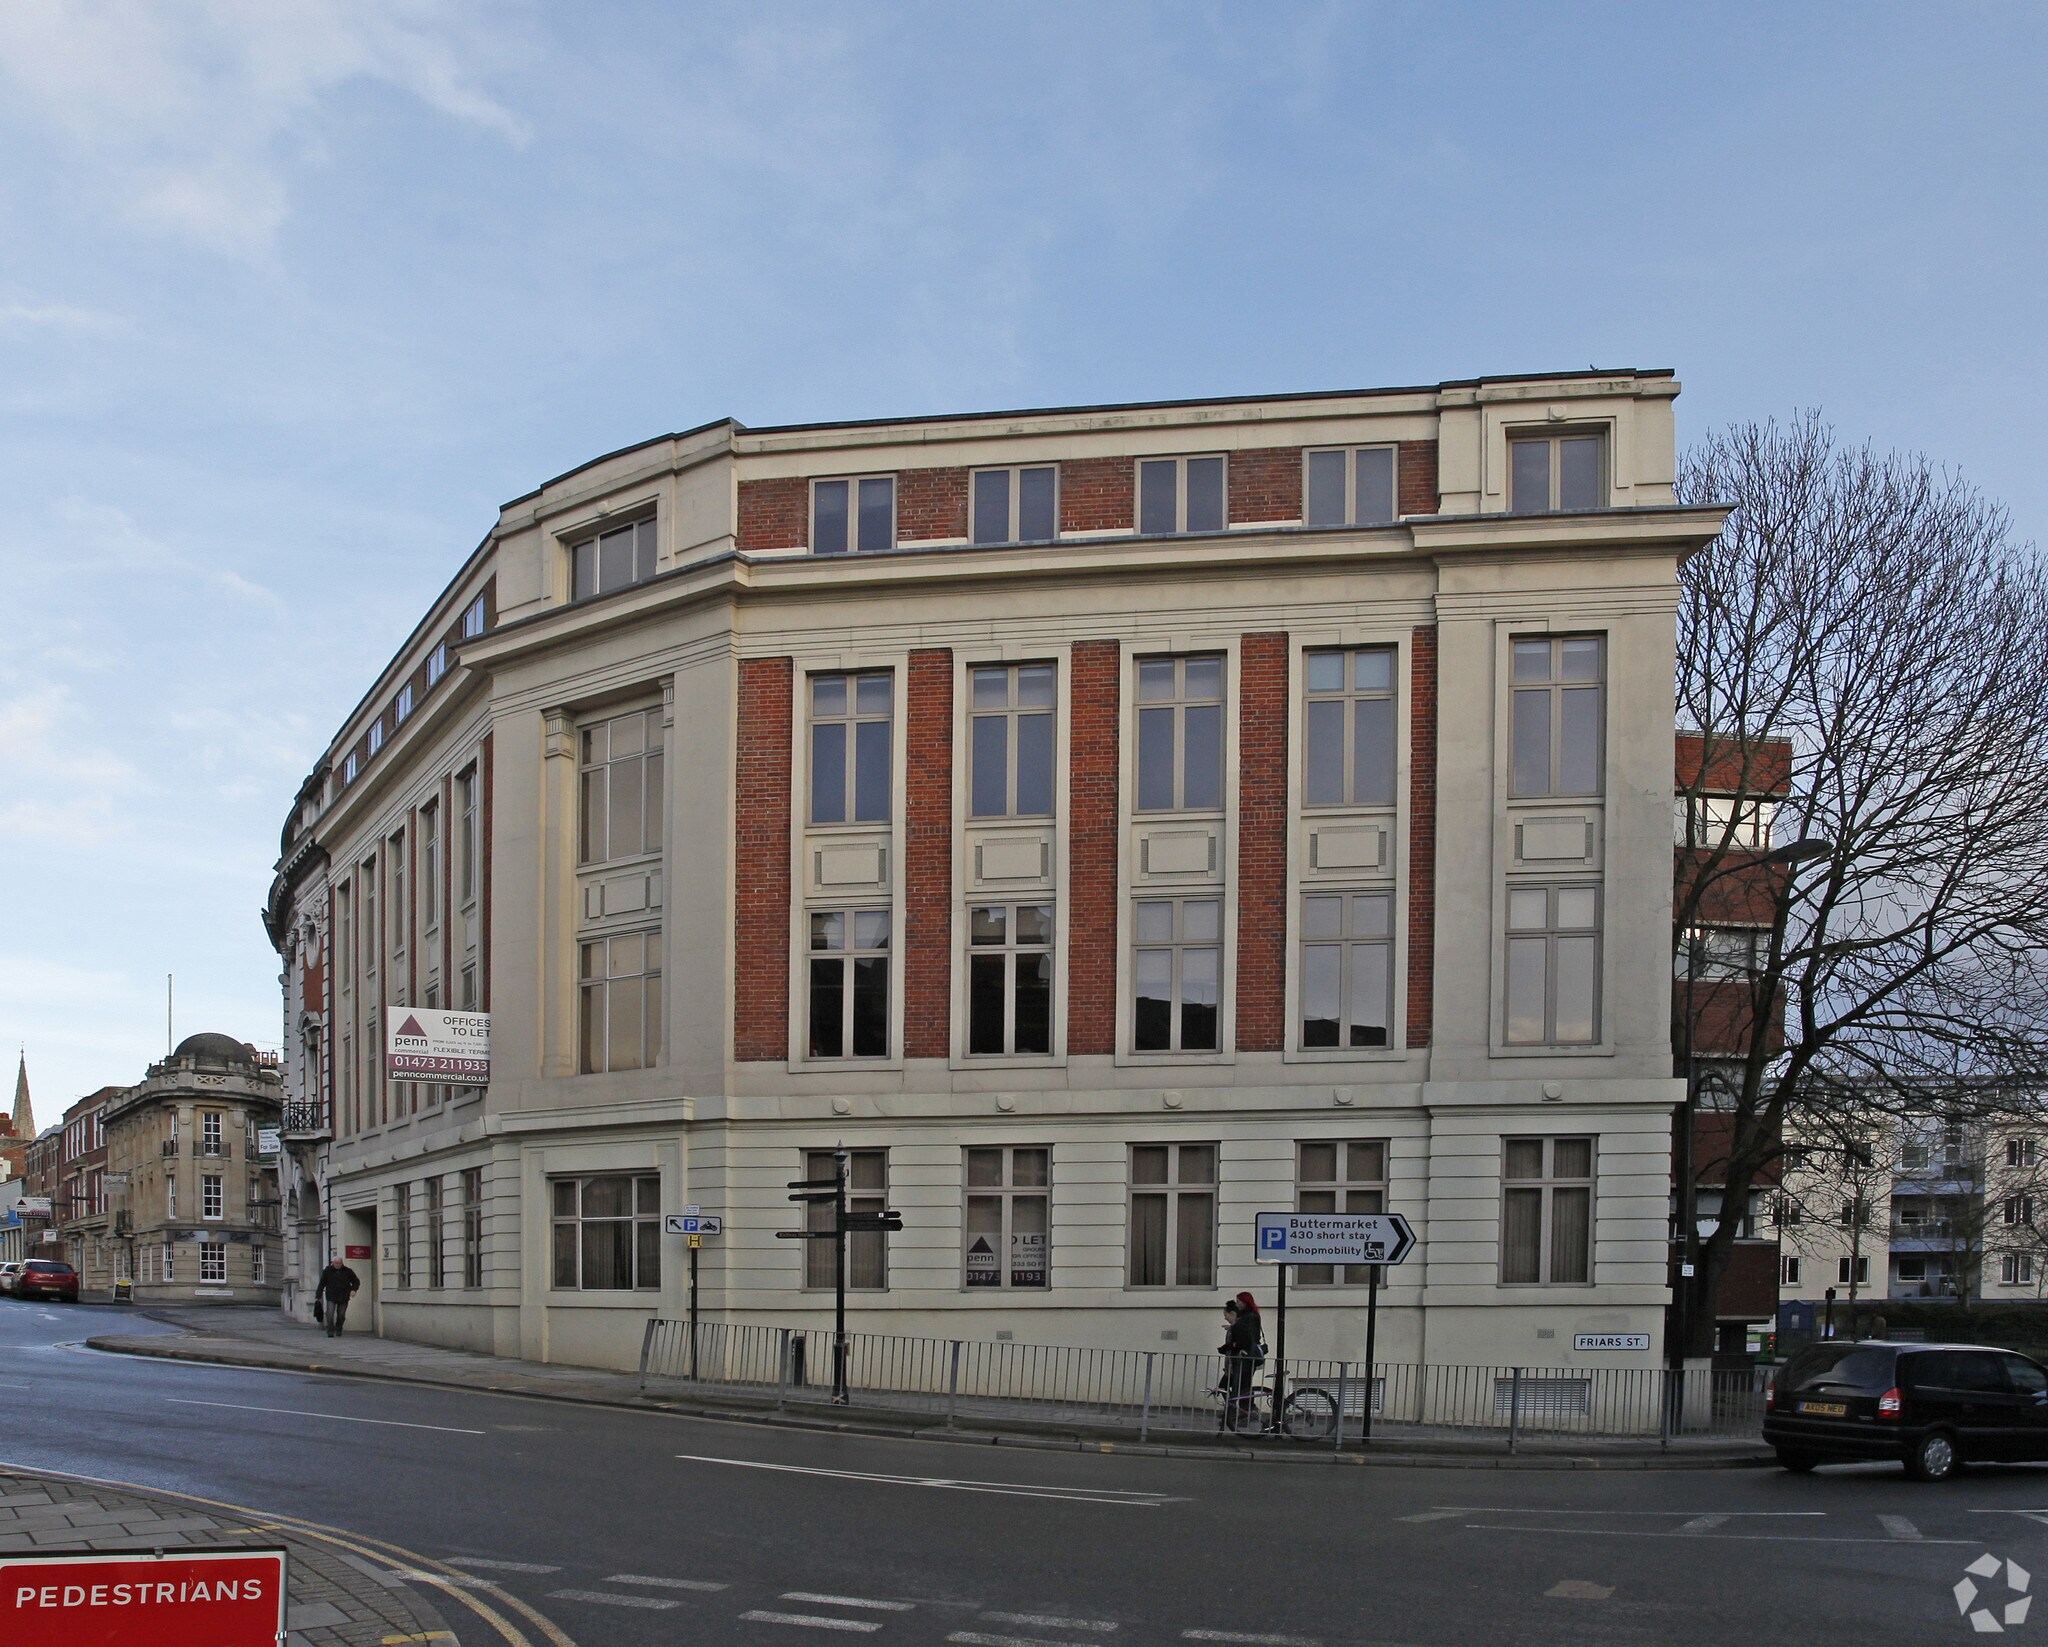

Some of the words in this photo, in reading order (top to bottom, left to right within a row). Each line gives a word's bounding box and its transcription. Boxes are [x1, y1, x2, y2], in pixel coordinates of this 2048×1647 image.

[443, 1016, 491, 1028] OFFICES
[451, 1027, 467, 1036] TO
[470, 1029, 491, 1037] LET
[395, 1037, 428, 1047] penn
[433, 1047, 466, 1055] FLEXIBLE
[395, 1056, 436, 1068] 01473
[440, 1058, 488, 1071] 211933
[393, 1070, 490, 1082] penncommercial.co.uk
[686, 1220, 697, 1231] P
[1290, 1218, 1378, 1229] Buttermarket
[1023, 1235, 1046, 1245] LET
[1266, 1229, 1283, 1248] P
[1290, 1231, 1314, 1239] 430
[1317, 1231, 1345, 1239] short
[1349, 1231, 1371, 1241] stay
[1290, 1245, 1361, 1256] Shopmobility
[967, 1254, 994, 1264] penn
[967, 1272, 1000, 1281] 01473
[1580, 1338, 1622, 1347] FRIARS
[1626, 1338, 1643, 1346] ST.
[15, 1579, 262, 1609] PEDESTRIANS
